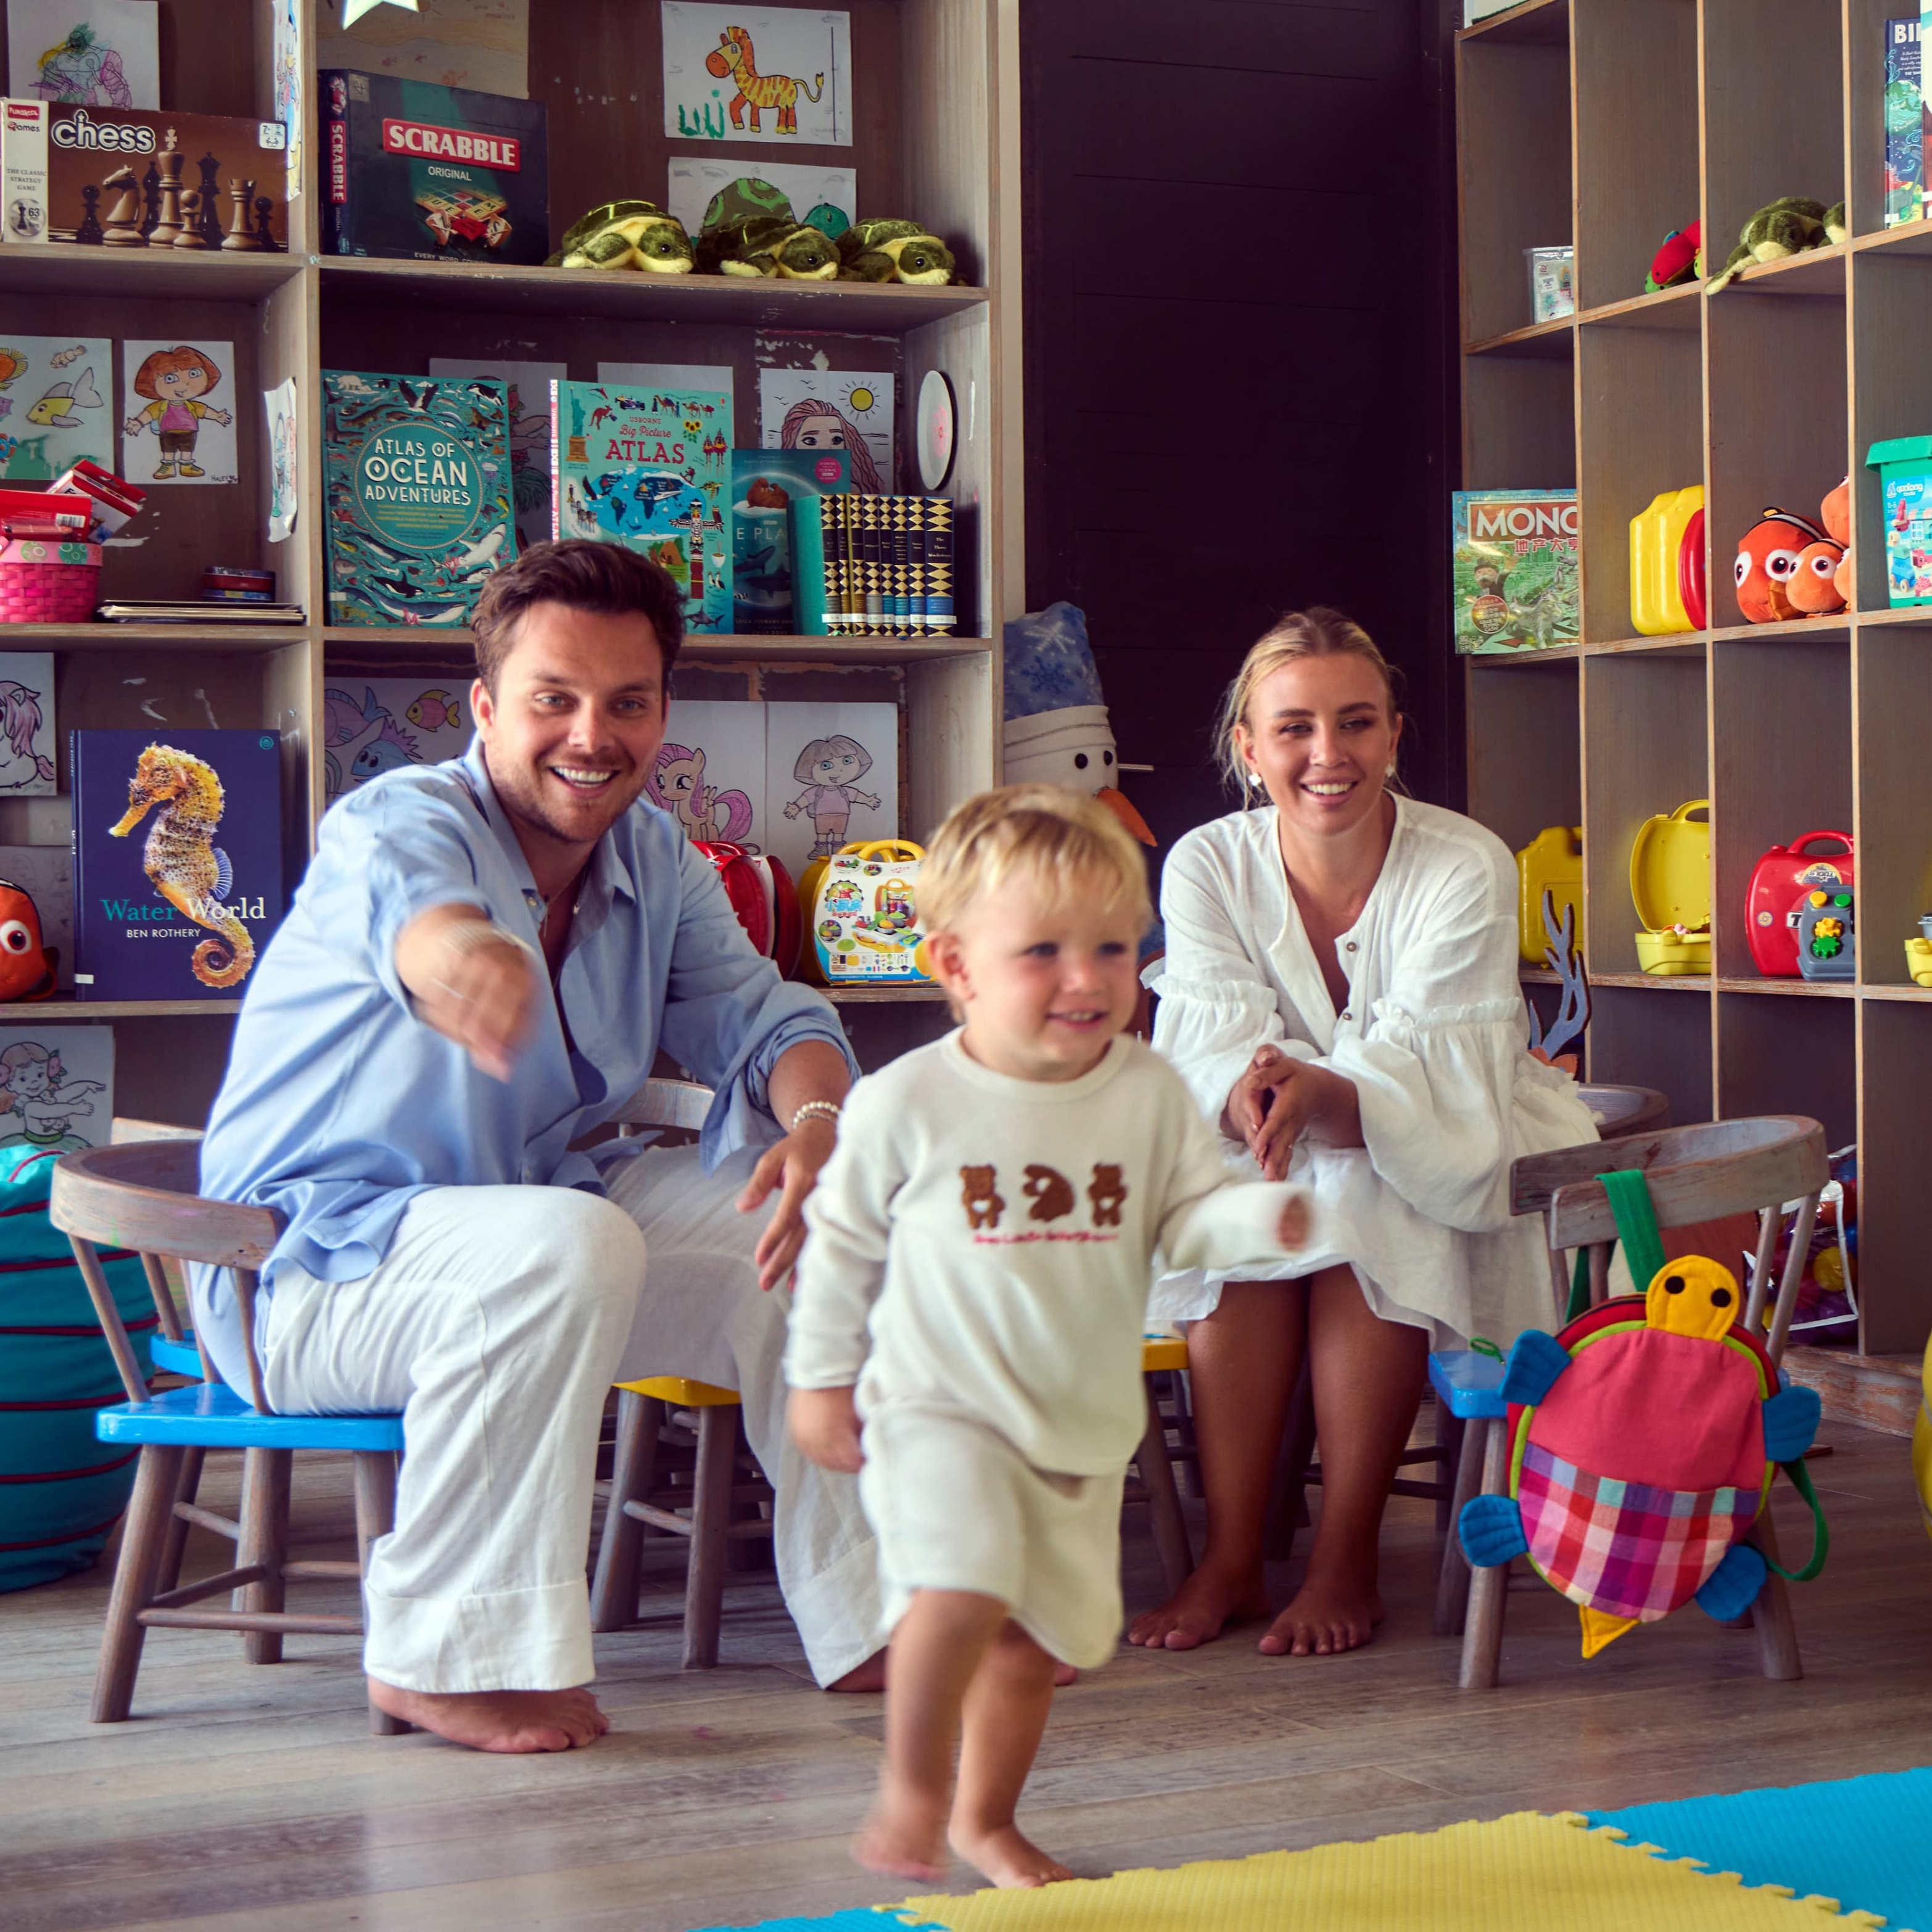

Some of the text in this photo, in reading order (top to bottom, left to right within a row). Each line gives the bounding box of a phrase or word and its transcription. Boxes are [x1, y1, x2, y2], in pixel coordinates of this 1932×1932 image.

[53, 111, 155, 153] chess
[389, 125, 516, 167] SCRABBLE
[331, 124, 344, 201] SCRABBLE
[428, 166, 472, 181] ORIGINAL
[28, 207, 39, 217] 63
[415, 252, 436, 260] EVERY
[619, 424, 671, 437] Big Picture
[374, 439, 455, 459] ATLAS OF
[605, 439, 685, 464] ATLAS
[365, 456, 468, 487] OCEAN
[365, 485, 471, 505] ADVENTURES
[101, 897, 266, 921] Water World
[126, 928, 201, 938] BEN ROTHERY
